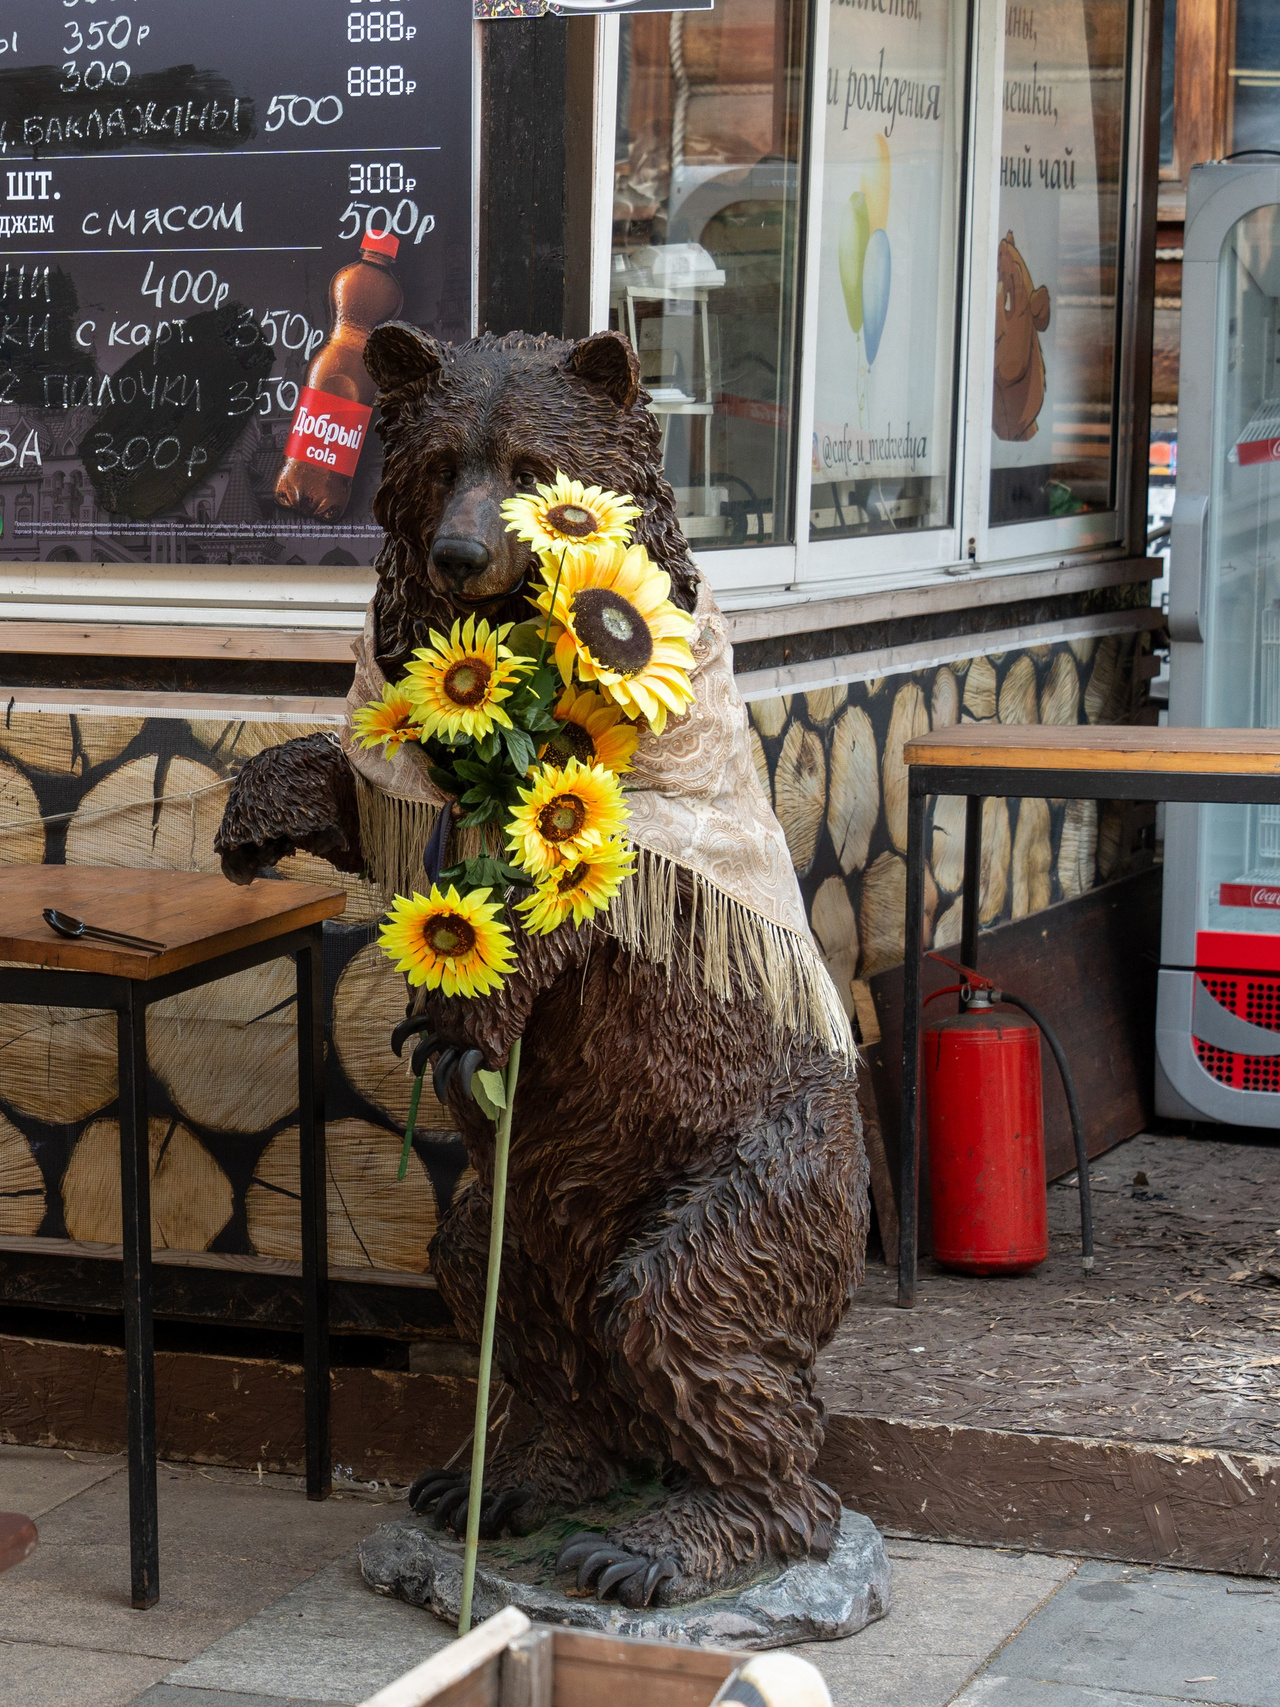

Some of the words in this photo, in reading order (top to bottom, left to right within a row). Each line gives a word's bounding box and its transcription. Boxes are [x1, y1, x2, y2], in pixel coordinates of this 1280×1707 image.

[347, 10, 417, 43] 888₽
[60, 60, 131, 92] 300
[347, 65, 416, 97] 888₽
[842, 47, 941, 137] рождения
[265, 94, 343, 132] 500
[348, 163, 416, 194] 300₽
[1039, 147, 1076, 190] чай
[6, 171, 61, 200] ШТ.
[227, 376, 300, 417] 350
[292, 406, 363, 450] Добрый
[306, 446, 337, 465] cola
[823, 421, 927, 476] @cafe_u_medvedya
[1253, 887, 1280, 906] Coca
